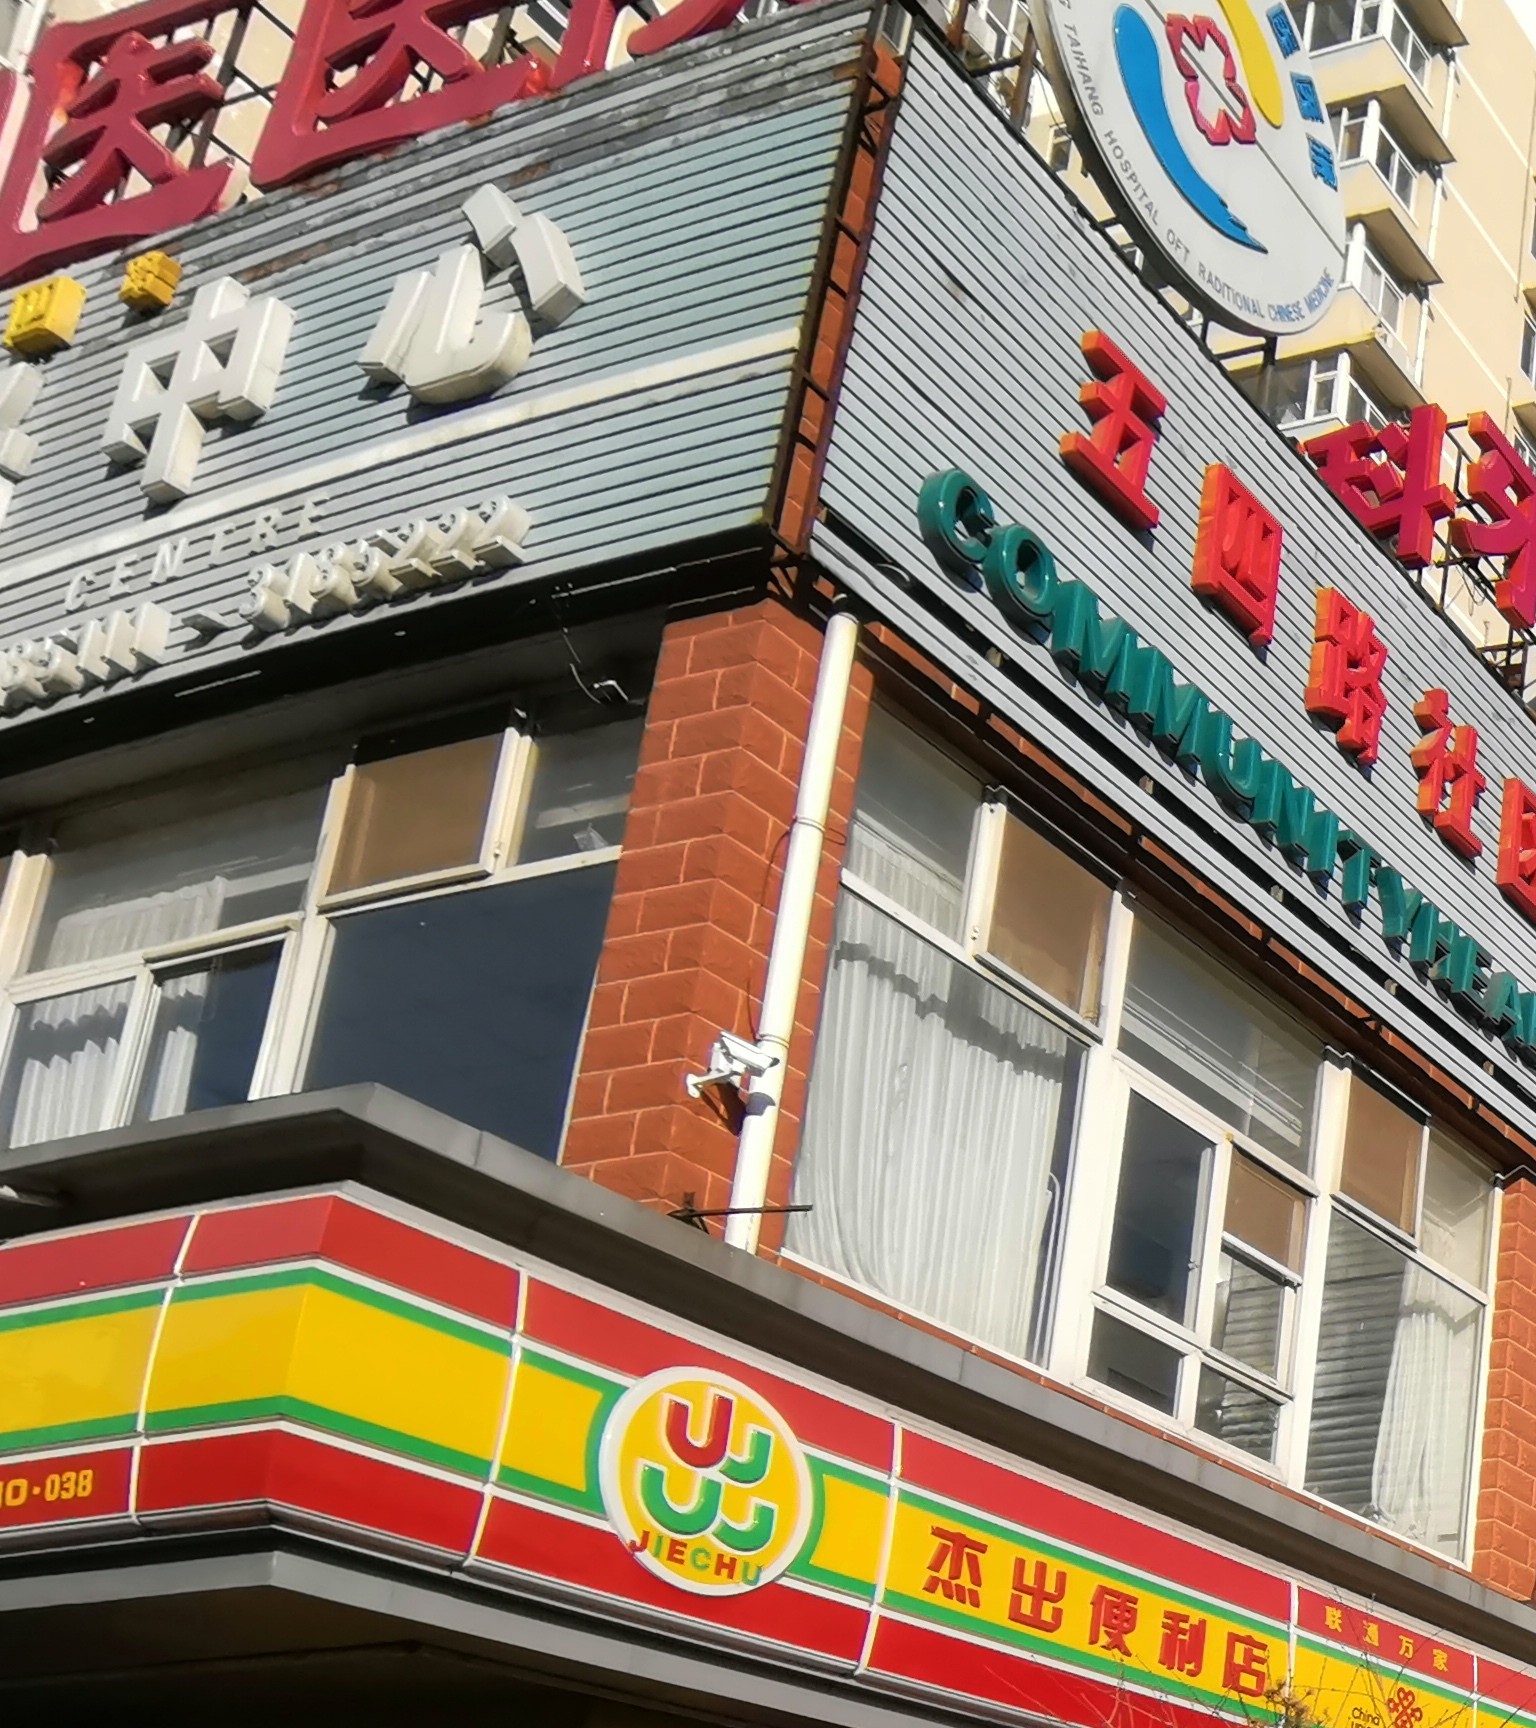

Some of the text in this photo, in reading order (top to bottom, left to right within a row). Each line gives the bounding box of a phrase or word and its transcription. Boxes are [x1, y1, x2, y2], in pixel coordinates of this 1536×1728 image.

[1063, 22, 1104, 117] TAIHANG
[1103, 129, 1160, 226] HOSPITAL
[0, 183, 586, 504] 中心
[63, 491, 331, 613] CENTRE
[627, 1529, 764, 1587] JIECHU
[922, 1525, 1269, 1698] 杰出便利店
[1324, 1605, 1449, 1673] 联通万家
[1351, 1706, 1380, 1726] China
